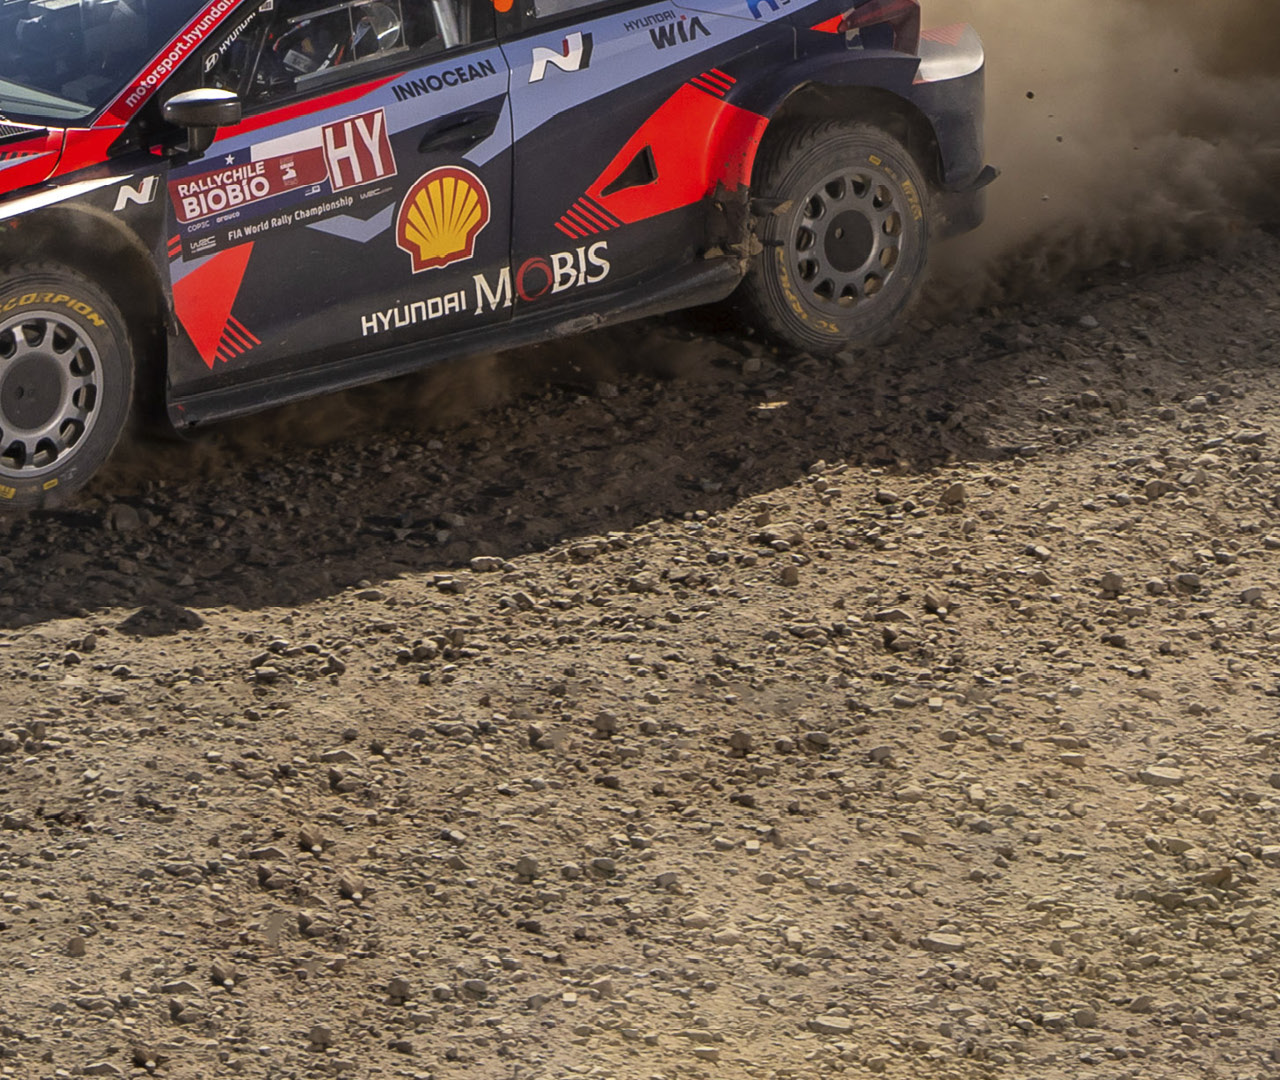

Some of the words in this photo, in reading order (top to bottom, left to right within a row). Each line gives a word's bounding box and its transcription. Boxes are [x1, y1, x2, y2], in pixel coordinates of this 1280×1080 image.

[624, 9, 677, 32] HYUNDAI
[528, 31, 594, 83] N
[391, 58, 497, 102] INNOCEAN
[177, 161, 265, 198] RALLYCHILE
[324, 111, 385, 188] HY
[113, 175, 160, 211] N
[182, 176, 270, 220] BIOBÍO
[228, 228, 243, 241] FIA
[244, 220, 270, 236] World
[271, 213, 293, 229] Rally
[294, 195, 353, 221] Championship
[360, 290, 467, 336] HYUNDAI
[473, 241, 611, 315] MOBIS
